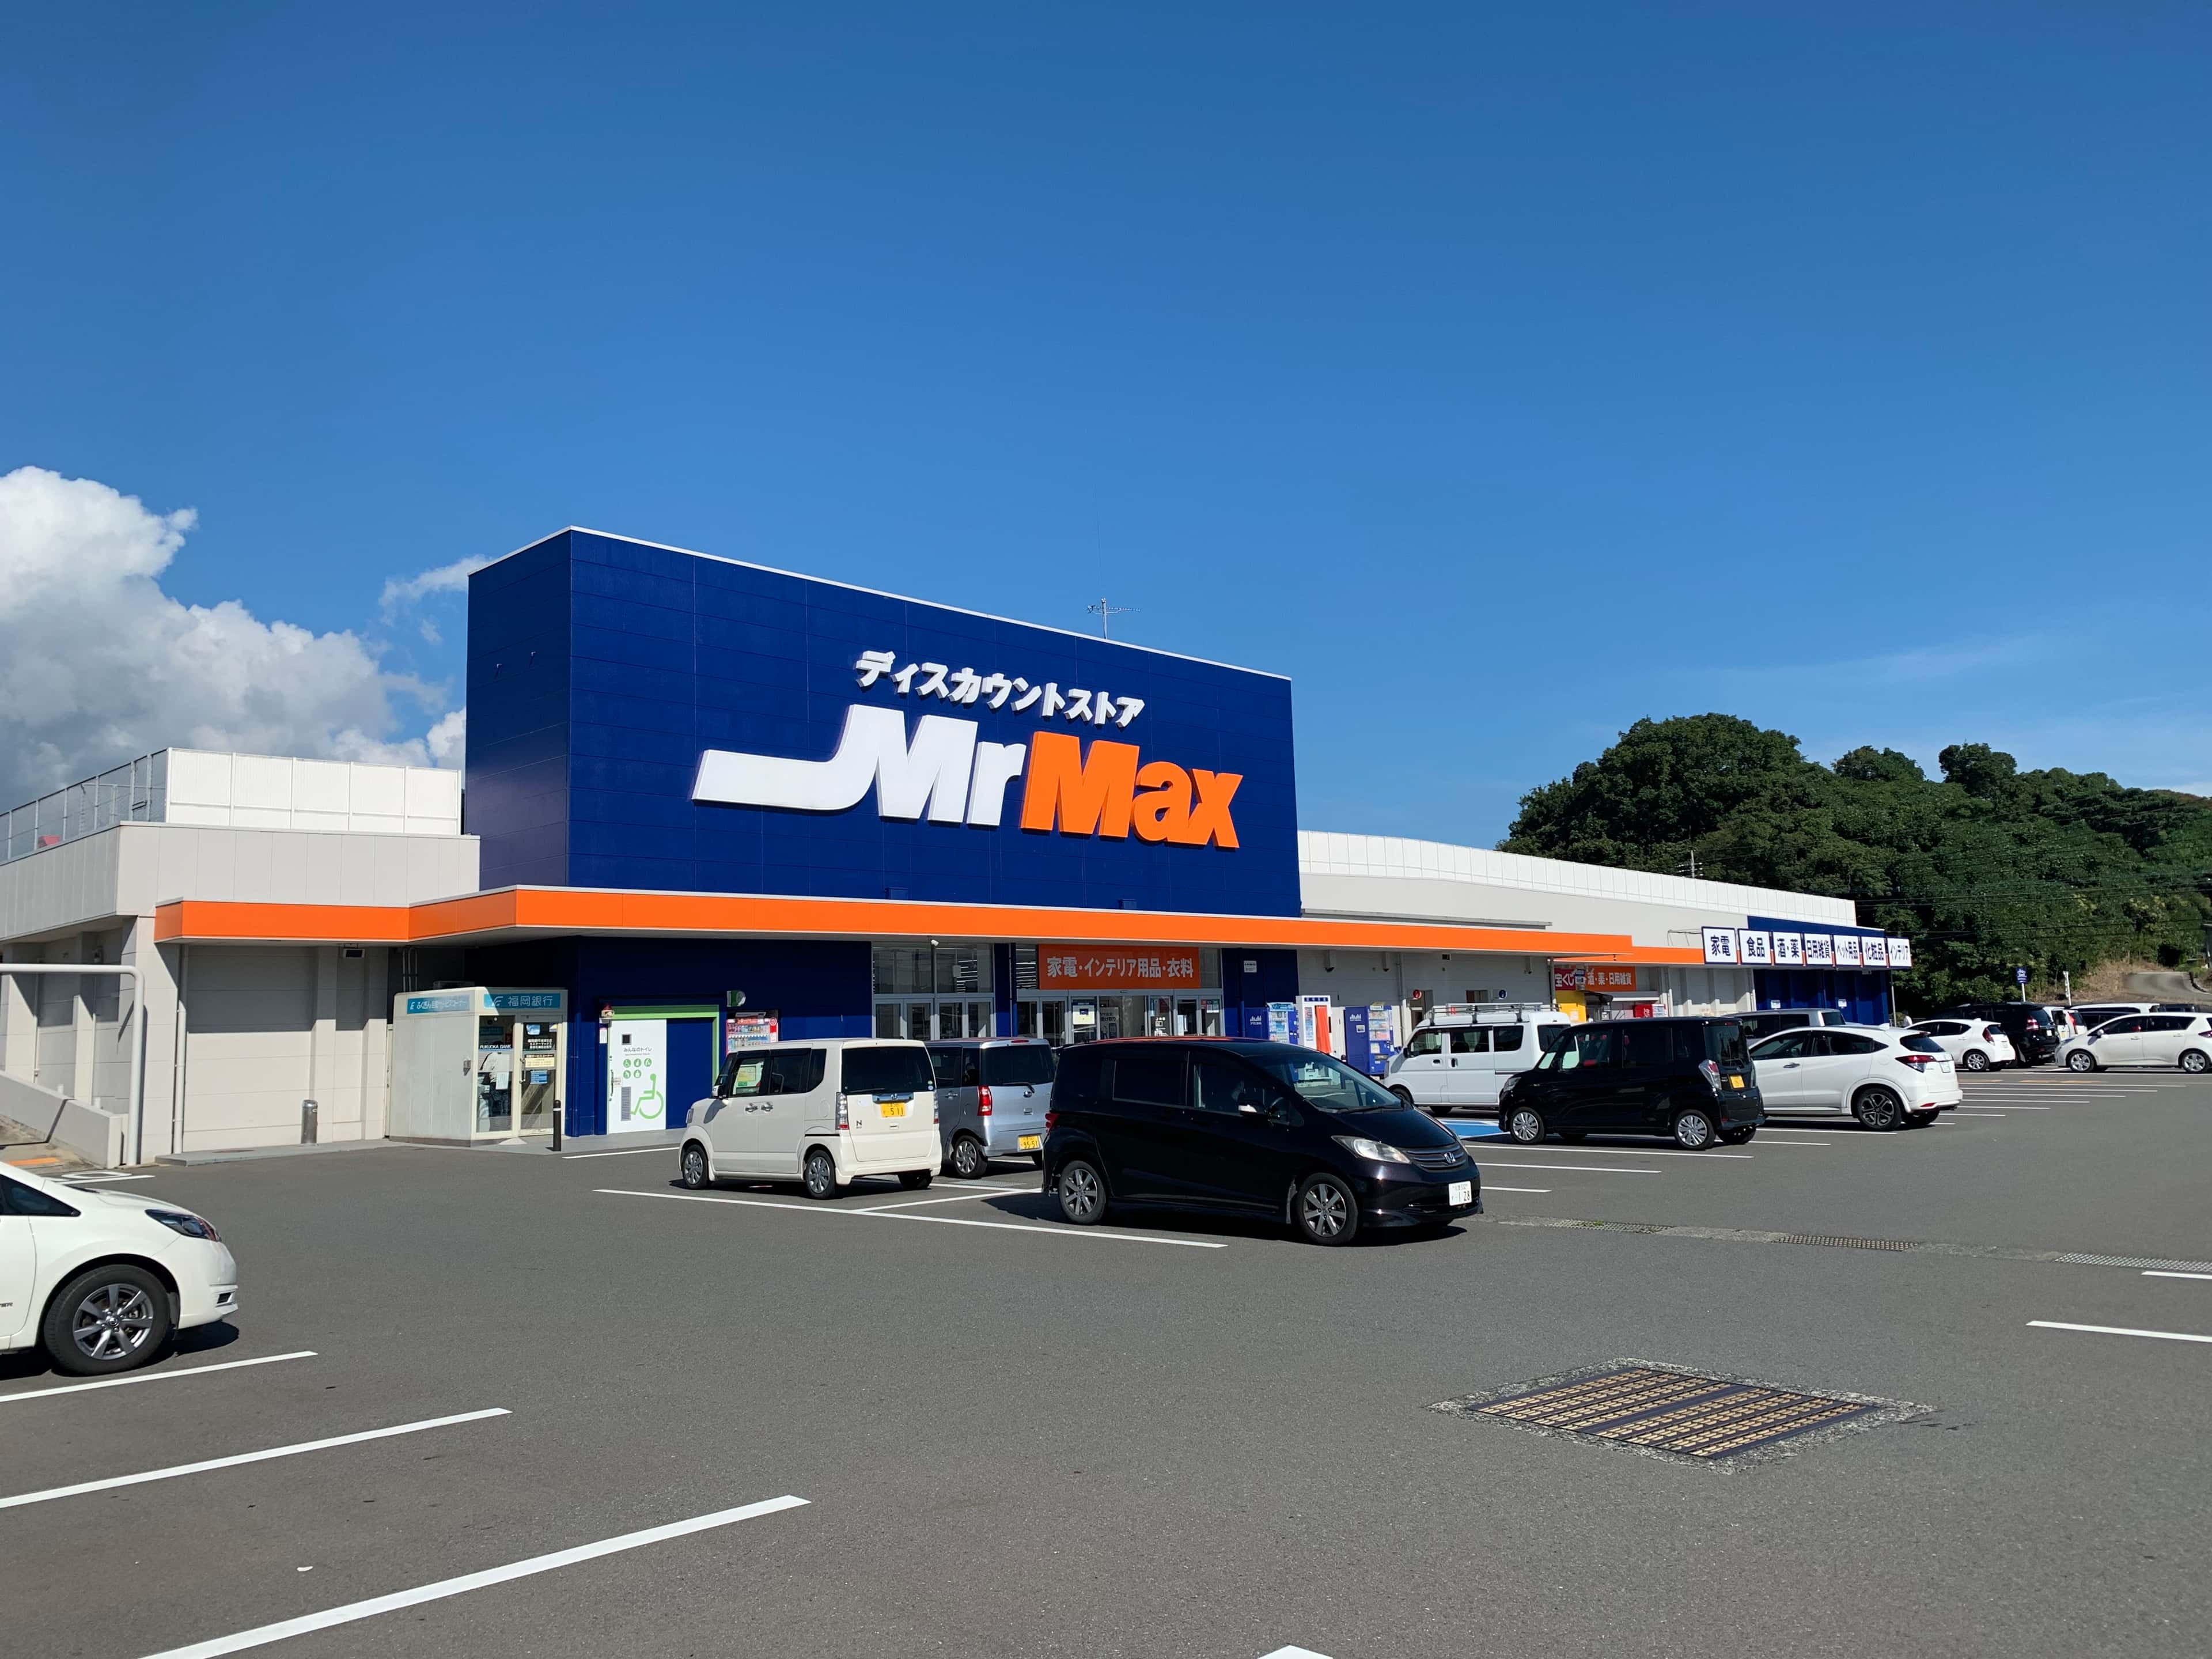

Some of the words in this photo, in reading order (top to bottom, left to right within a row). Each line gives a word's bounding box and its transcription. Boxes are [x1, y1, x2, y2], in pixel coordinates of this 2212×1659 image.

[855, 650, 1146, 728] ディスカウントストア
[692, 704, 1243, 849] MrMax
[1710, 935, 1730, 957] 家電
[1747, 937, 1765, 957] 食品
[1777, 938, 1800, 958] 酒・薬
[1806, 940, 1831, 959] 日用雑貨
[1837, 941, 1858, 959] ペット用品
[1865, 942, 1884, 960] 化粧品
[1890, 945, 1908, 960] インテリア
[1047, 956, 1194, 978] 家電・インテリア用品・衣料
[507, 996, 553, 1006] 福岡銀行
